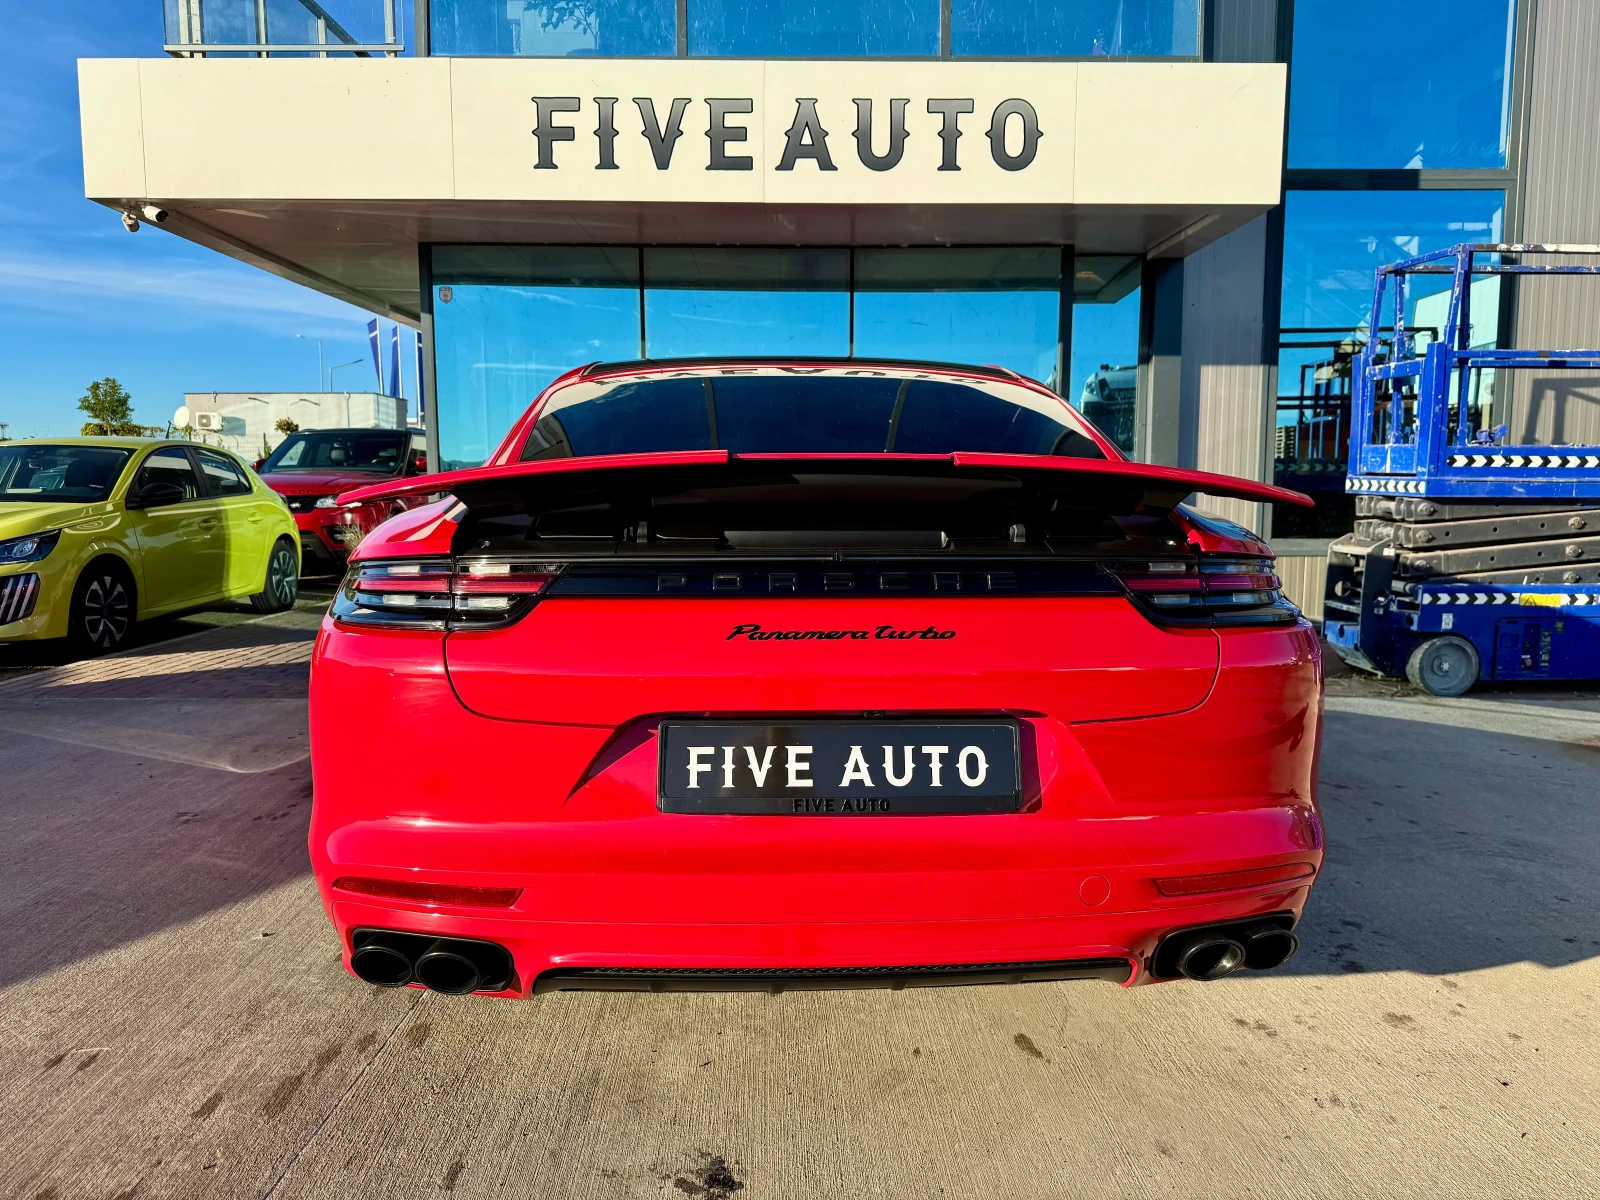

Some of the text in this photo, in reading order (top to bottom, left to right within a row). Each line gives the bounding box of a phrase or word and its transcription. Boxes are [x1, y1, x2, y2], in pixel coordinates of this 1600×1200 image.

[656, 571, 1018, 592] PORSCHE
[725, 623, 870, 641] Panamera
[686, 745, 990, 789] FIVE AUTO
[792, 798, 890, 812] FIVE AUTO
